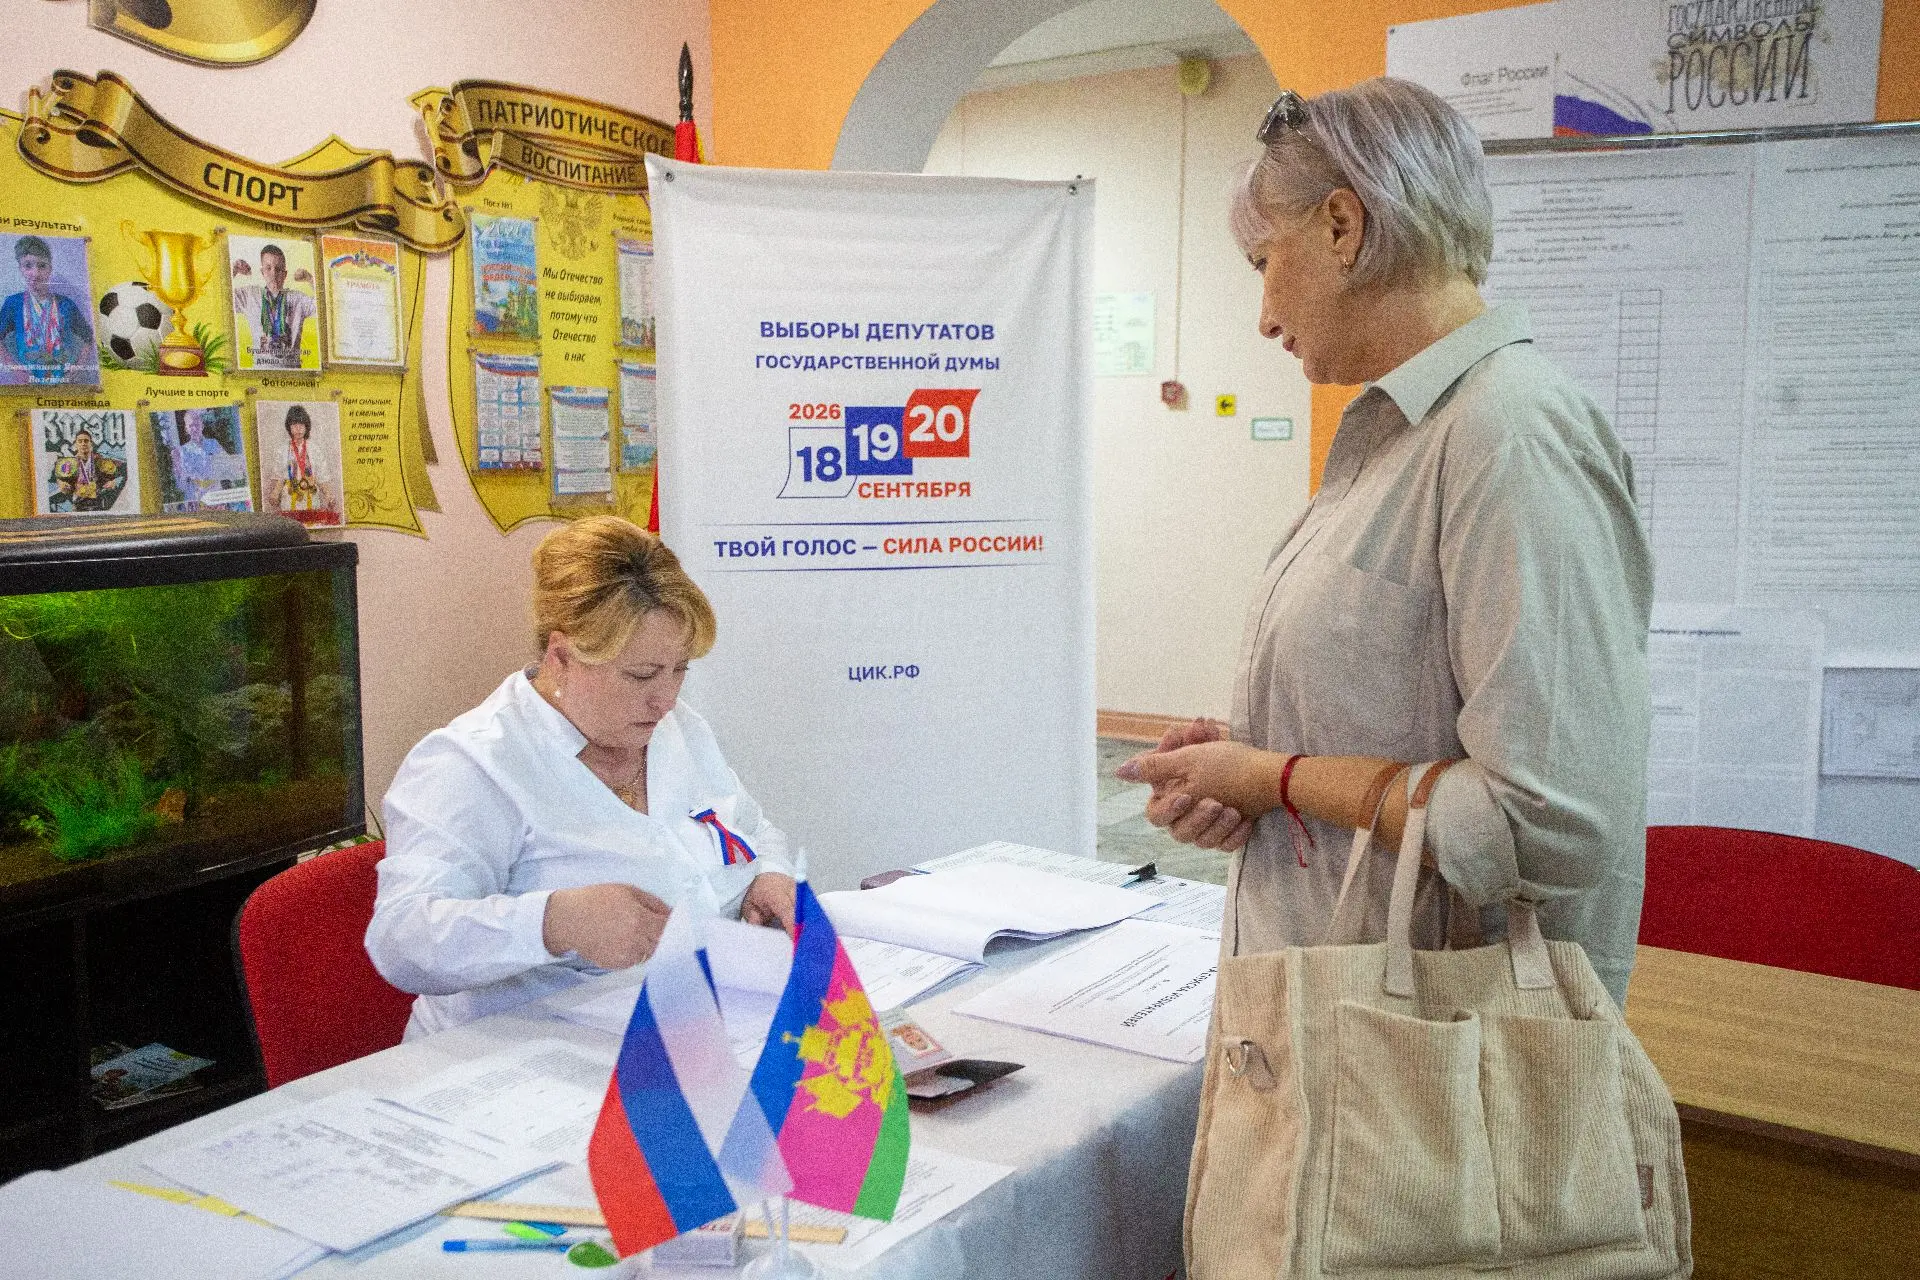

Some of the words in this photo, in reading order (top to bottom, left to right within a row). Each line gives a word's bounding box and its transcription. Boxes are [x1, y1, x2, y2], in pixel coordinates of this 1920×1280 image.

[1667, 13, 1815, 50] СИМВОЛЫ
[1461, 72, 1494, 88] Флаг
[1499, 65, 1548, 82] России
[1665, 32, 1813, 115] РОССИИ
[478, 99, 670, 156] ПАТРИОТИЧЕСКОЕ
[521, 144, 637, 184] ВОСПИТАНИЕ
[203, 161, 304, 211] СПОРТ
[14, 218, 82, 232] результаты
[543, 268, 558, 280] Мы
[560, 269, 604, 285] Отечество
[545, 292, 556, 300] не
[557, 291, 602, 306] выбираем,
[550, 312, 582, 325] потому
[583, 315, 598, 323] что
[552, 329, 596, 344] Отечество
[760, 321, 859, 339] ВЫБОРЫ
[866, 323, 995, 342] ДЕПУТАТОВ
[564, 352, 570, 361] в
[571, 353, 586, 363] нас
[755, 353, 940, 371] ГОСУДАРСТВЕННОЙ
[945, 356, 999, 372] ДУМЫ
[261, 377, 320, 388] Фотомомент
[145, 387, 186, 398] Лучшие
[187, 389, 194, 397] в
[195, 389, 229, 399] спорте
[343, 397, 358, 405] Нам
[36, 397, 111, 409] Спартакиада
[789, 403, 841, 420] 2026
[909, 404, 965, 442] 20
[358, 434, 389, 442] спортом
[852, 423, 899, 462] 19
[796, 446, 843, 482] 18
[858, 482, 971, 499] СЕНТЯБРЯ
[714, 536, 776, 558] ТВОЙ
[782, 539, 857, 557] ГОЛОС
[883, 537, 943, 555] СИЛА
[949, 534, 1043, 554] РОССИИ!
[848, 664, 920, 682] ЦИК.РФ
